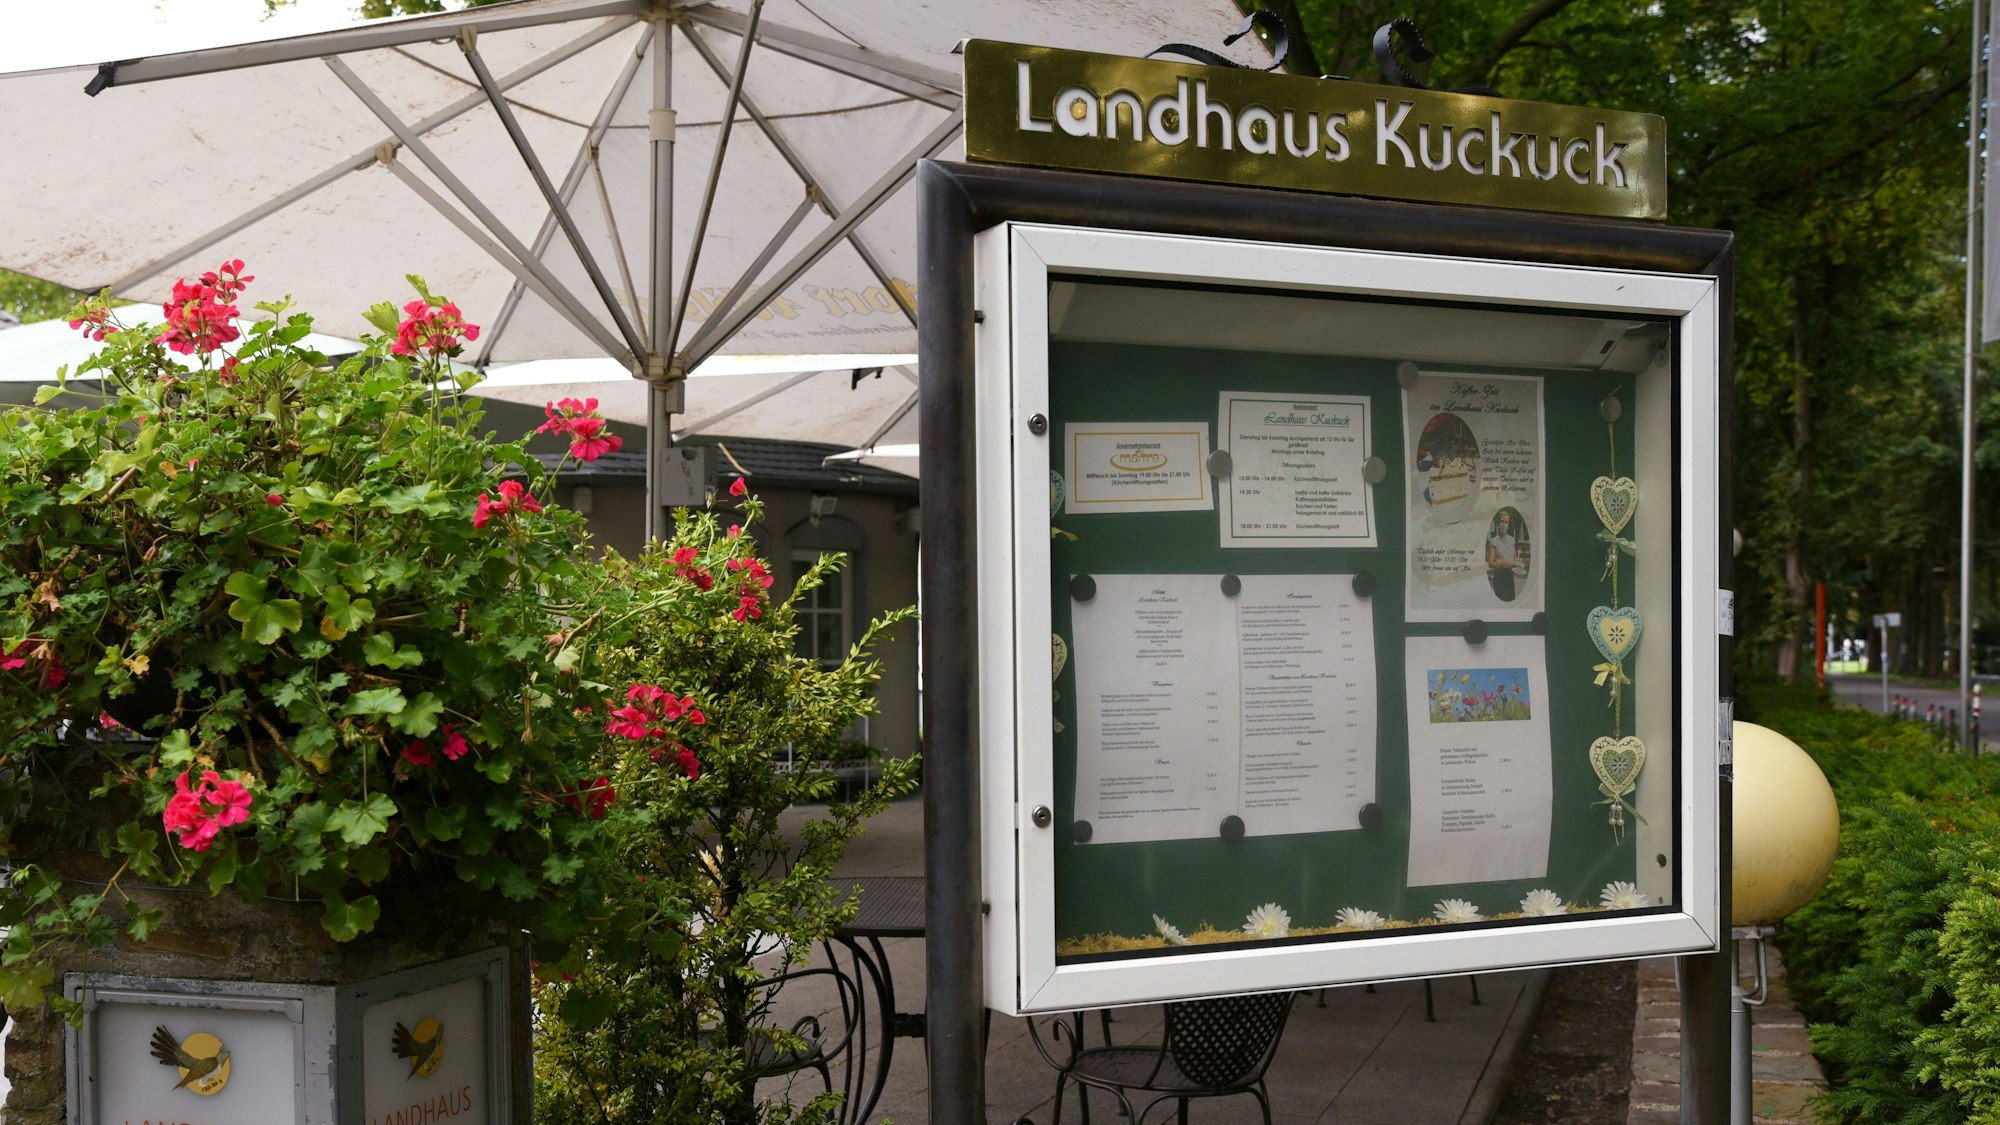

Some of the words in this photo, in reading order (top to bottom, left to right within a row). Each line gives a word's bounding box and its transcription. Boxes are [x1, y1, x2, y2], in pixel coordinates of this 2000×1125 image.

[1015, 59, 1351, 163] Landhaus
[1374, 99, 1630, 189] Kuckuck
[1264, 411, 1307, 425] Landhaus
[1310, 413, 1351, 426] Kuckuck
